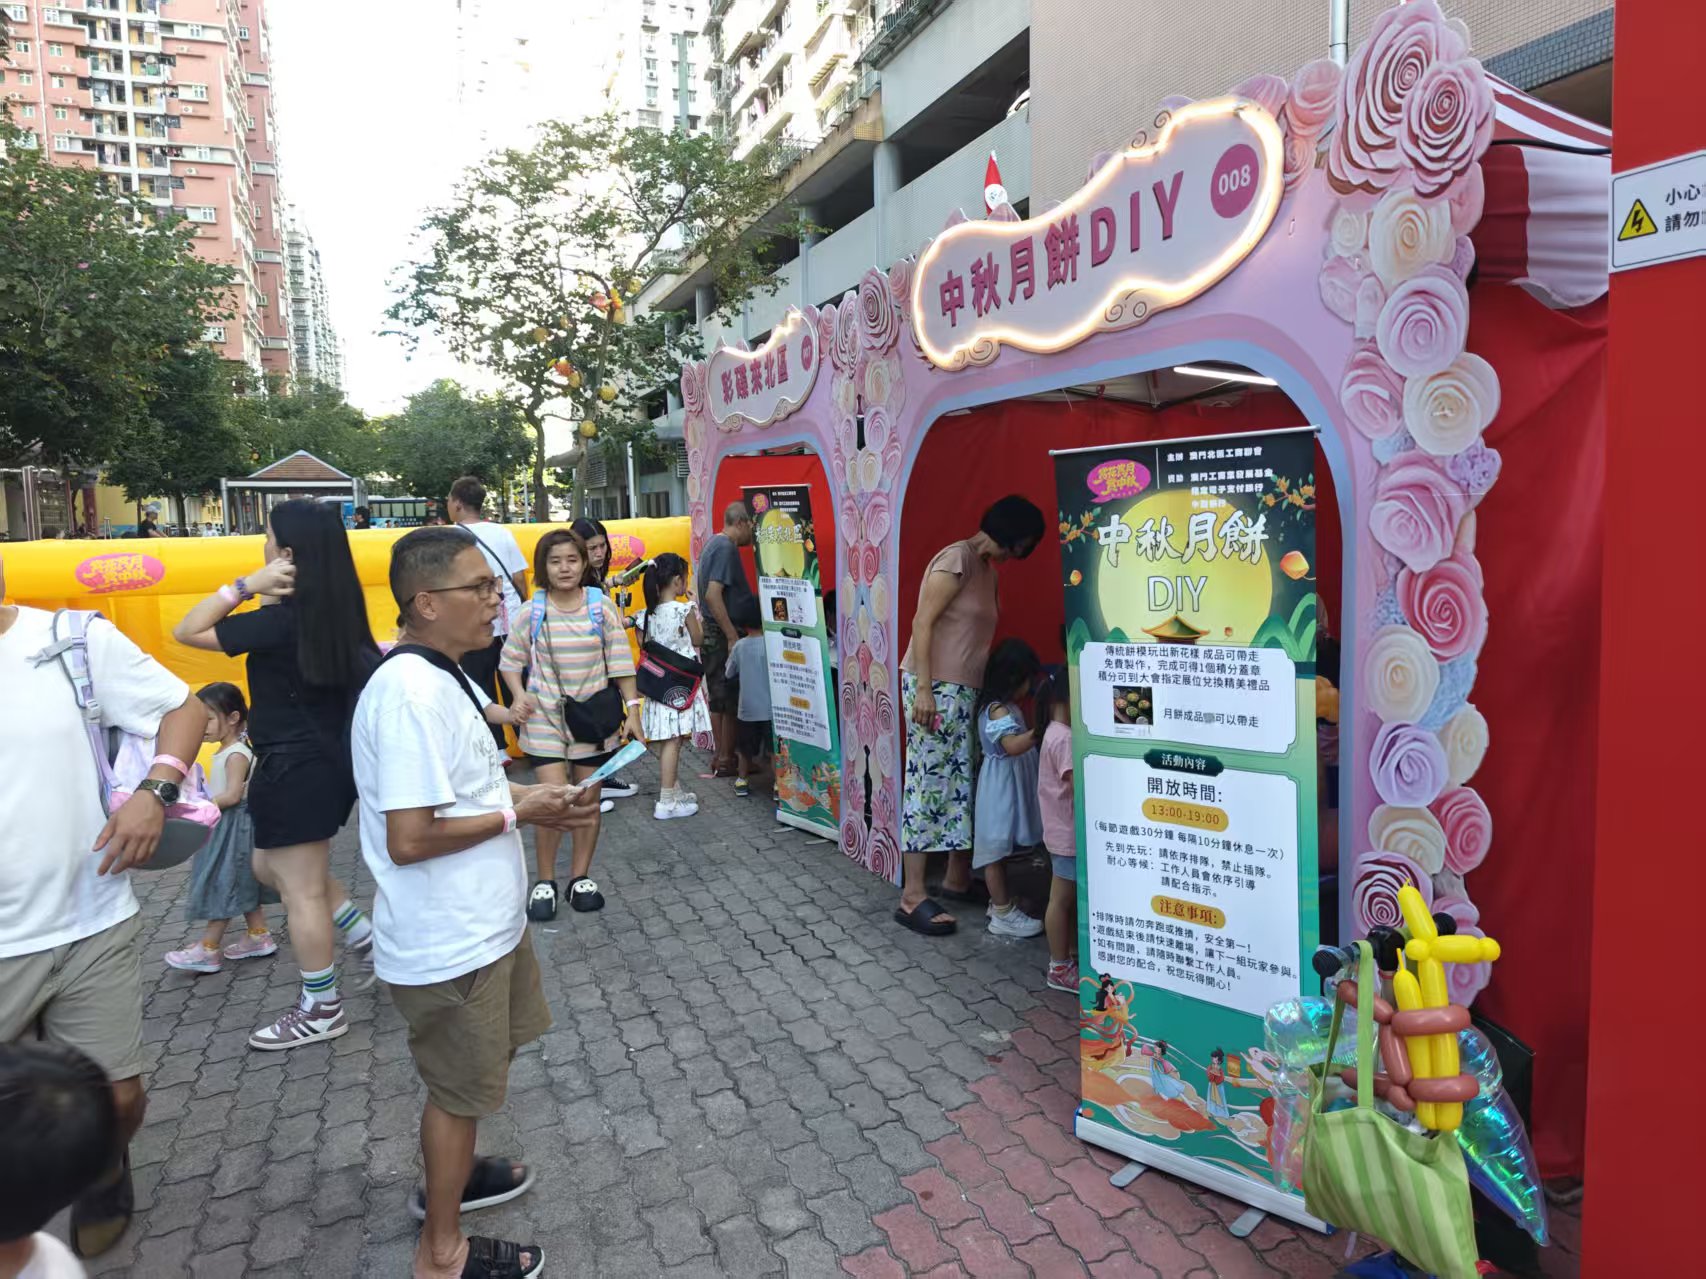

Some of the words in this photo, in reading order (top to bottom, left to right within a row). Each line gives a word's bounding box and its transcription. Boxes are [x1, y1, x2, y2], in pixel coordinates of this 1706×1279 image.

[1218, 165, 1251, 196] 008
[1665, 184, 1706, 206] 小心
[1665, 211, 1706, 233] 請勿
[939, 170, 1184, 328] 中秋月餅DIY
[1097, 510, 1270, 568] 中秋月餅
[1147, 576, 1208, 612] DIY
[1203, 649, 1260, 662] 成品可帶走
[1161, 753, 1207, 771] 活動內容
[1151, 804, 1220, 826] 13:00-19:00
